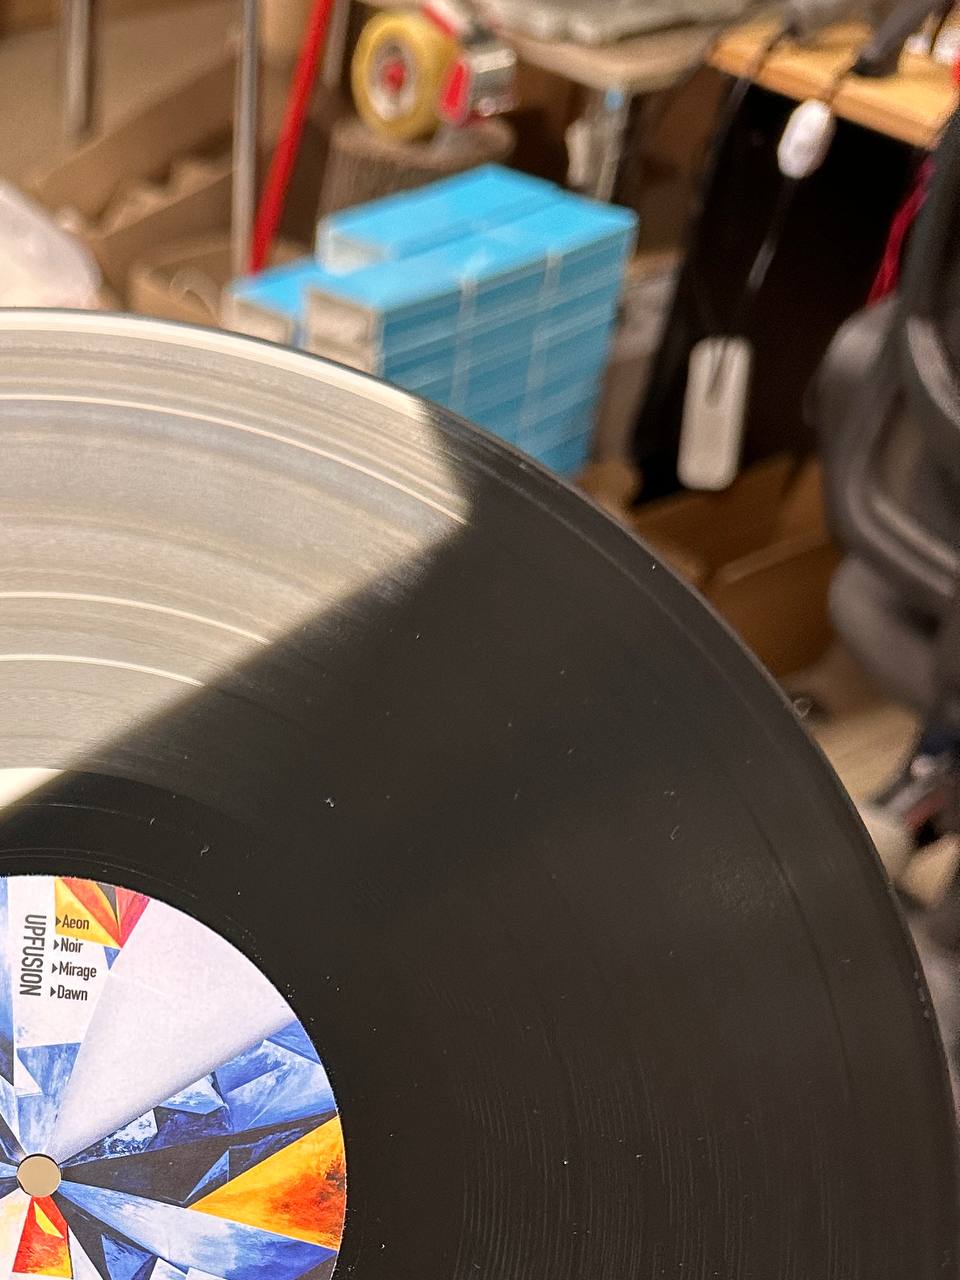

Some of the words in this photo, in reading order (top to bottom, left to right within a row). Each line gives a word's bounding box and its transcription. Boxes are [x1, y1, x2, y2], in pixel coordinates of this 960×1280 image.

[62, 914, 90, 930] Aeon
[60, 938, 84, 953] Noir
[19, 914, 47, 997] UPFUSION
[58, 961, 97, 981] Mirage
[57, 984, 88, 1001] Dawn
